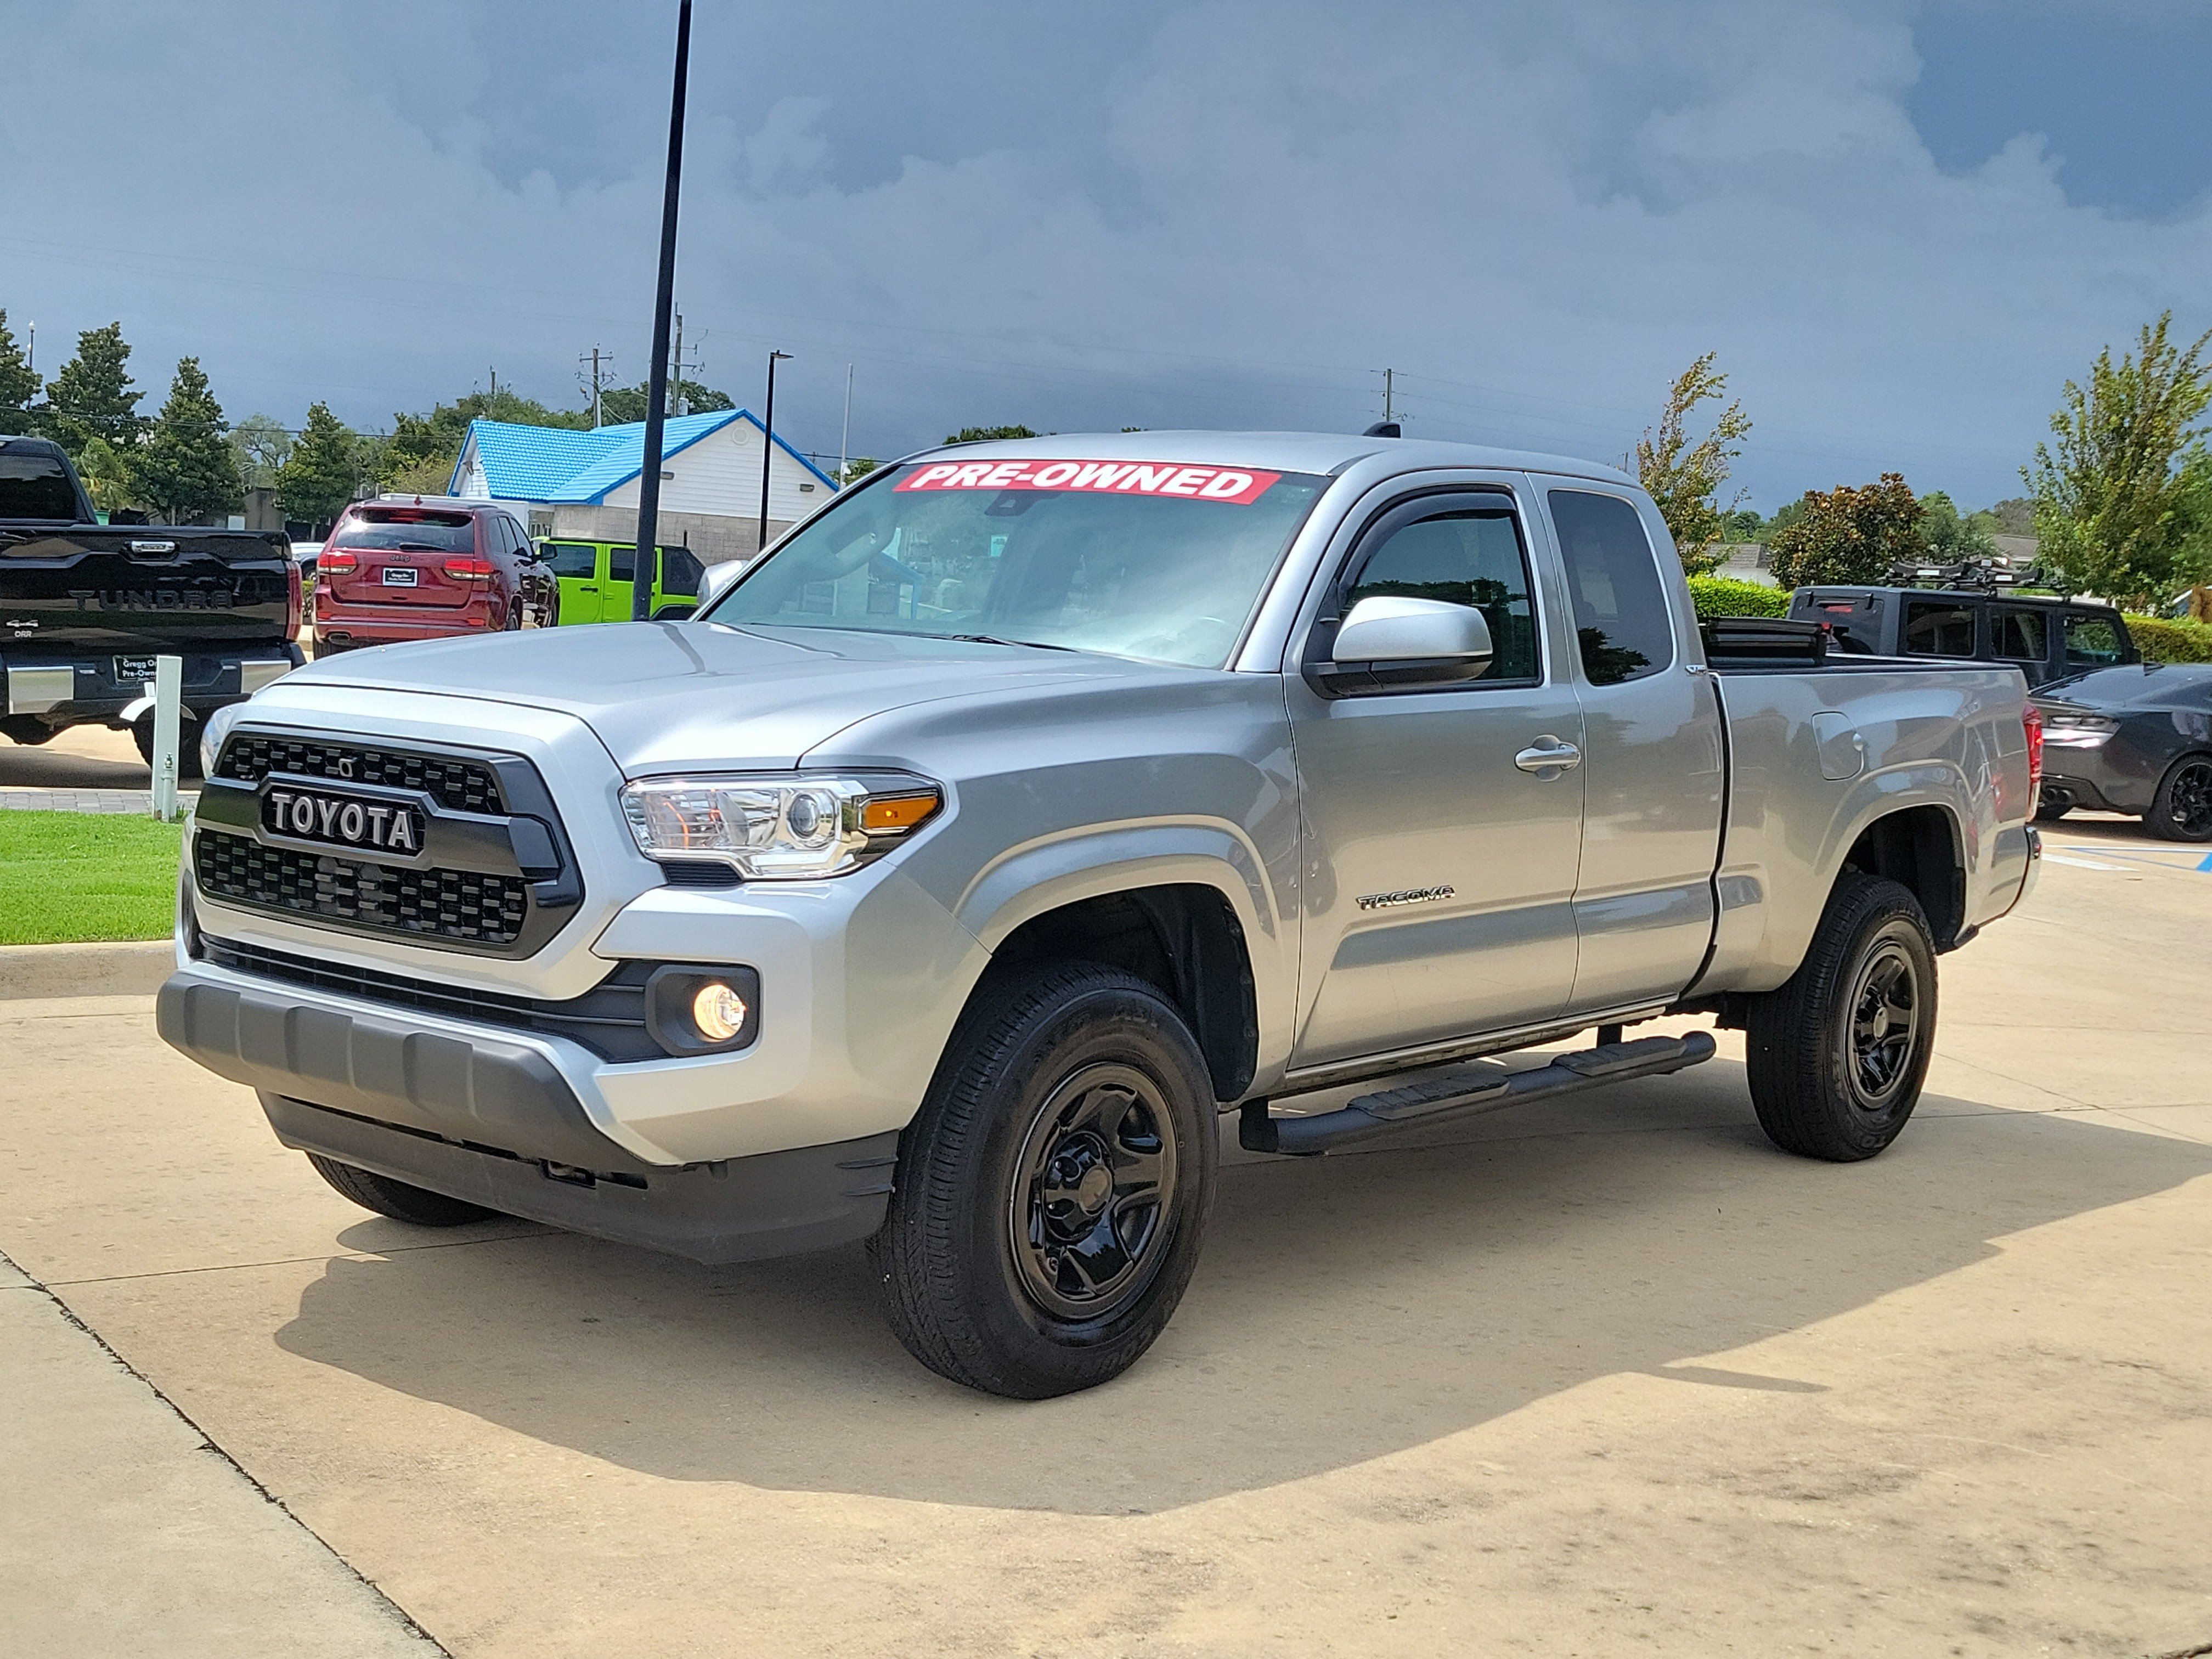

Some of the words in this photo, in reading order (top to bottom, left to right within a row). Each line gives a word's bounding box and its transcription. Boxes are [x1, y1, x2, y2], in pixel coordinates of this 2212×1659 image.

[909, 462, 1255, 498] PRE-OWNED
[69, 590, 233, 611] TUNDRA
[123, 660, 146, 669] Gregg
[272, 792, 417, 850] TOYOTA
[1356, 885, 1456, 910] TACOMA
